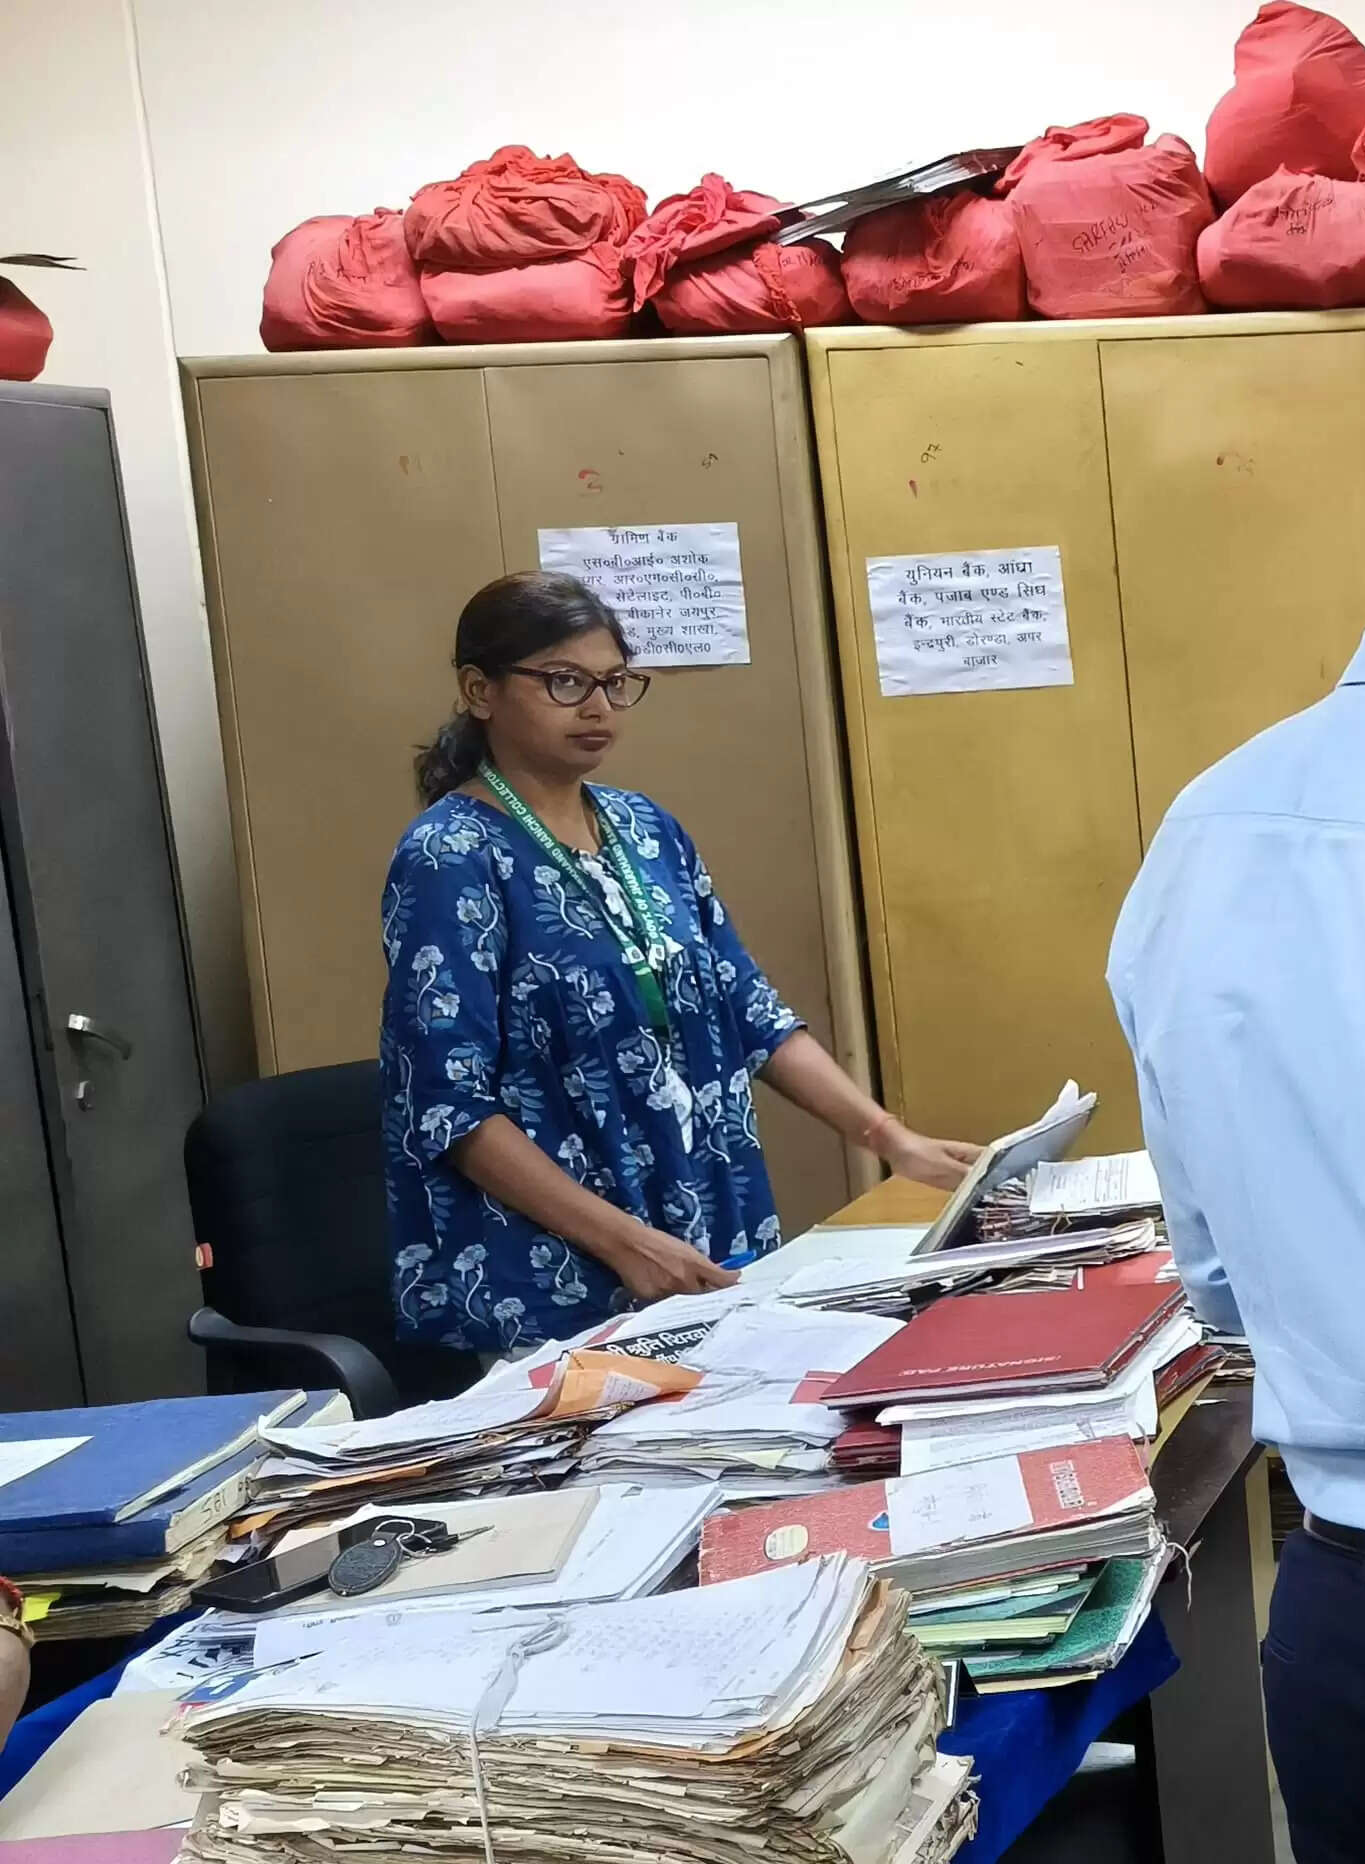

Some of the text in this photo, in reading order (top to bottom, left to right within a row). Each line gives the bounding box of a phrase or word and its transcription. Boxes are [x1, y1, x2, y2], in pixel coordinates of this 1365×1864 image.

[671, 549, 710, 566] अशोक
[981, 586, 1009, 602] एण्ड
[940, 610, 983, 627] भारतीय
[990, 608, 1015, 623] स्टेट
[1016, 630, 1042, 643] अपर
[962, 654, 999, 669] बाजार
